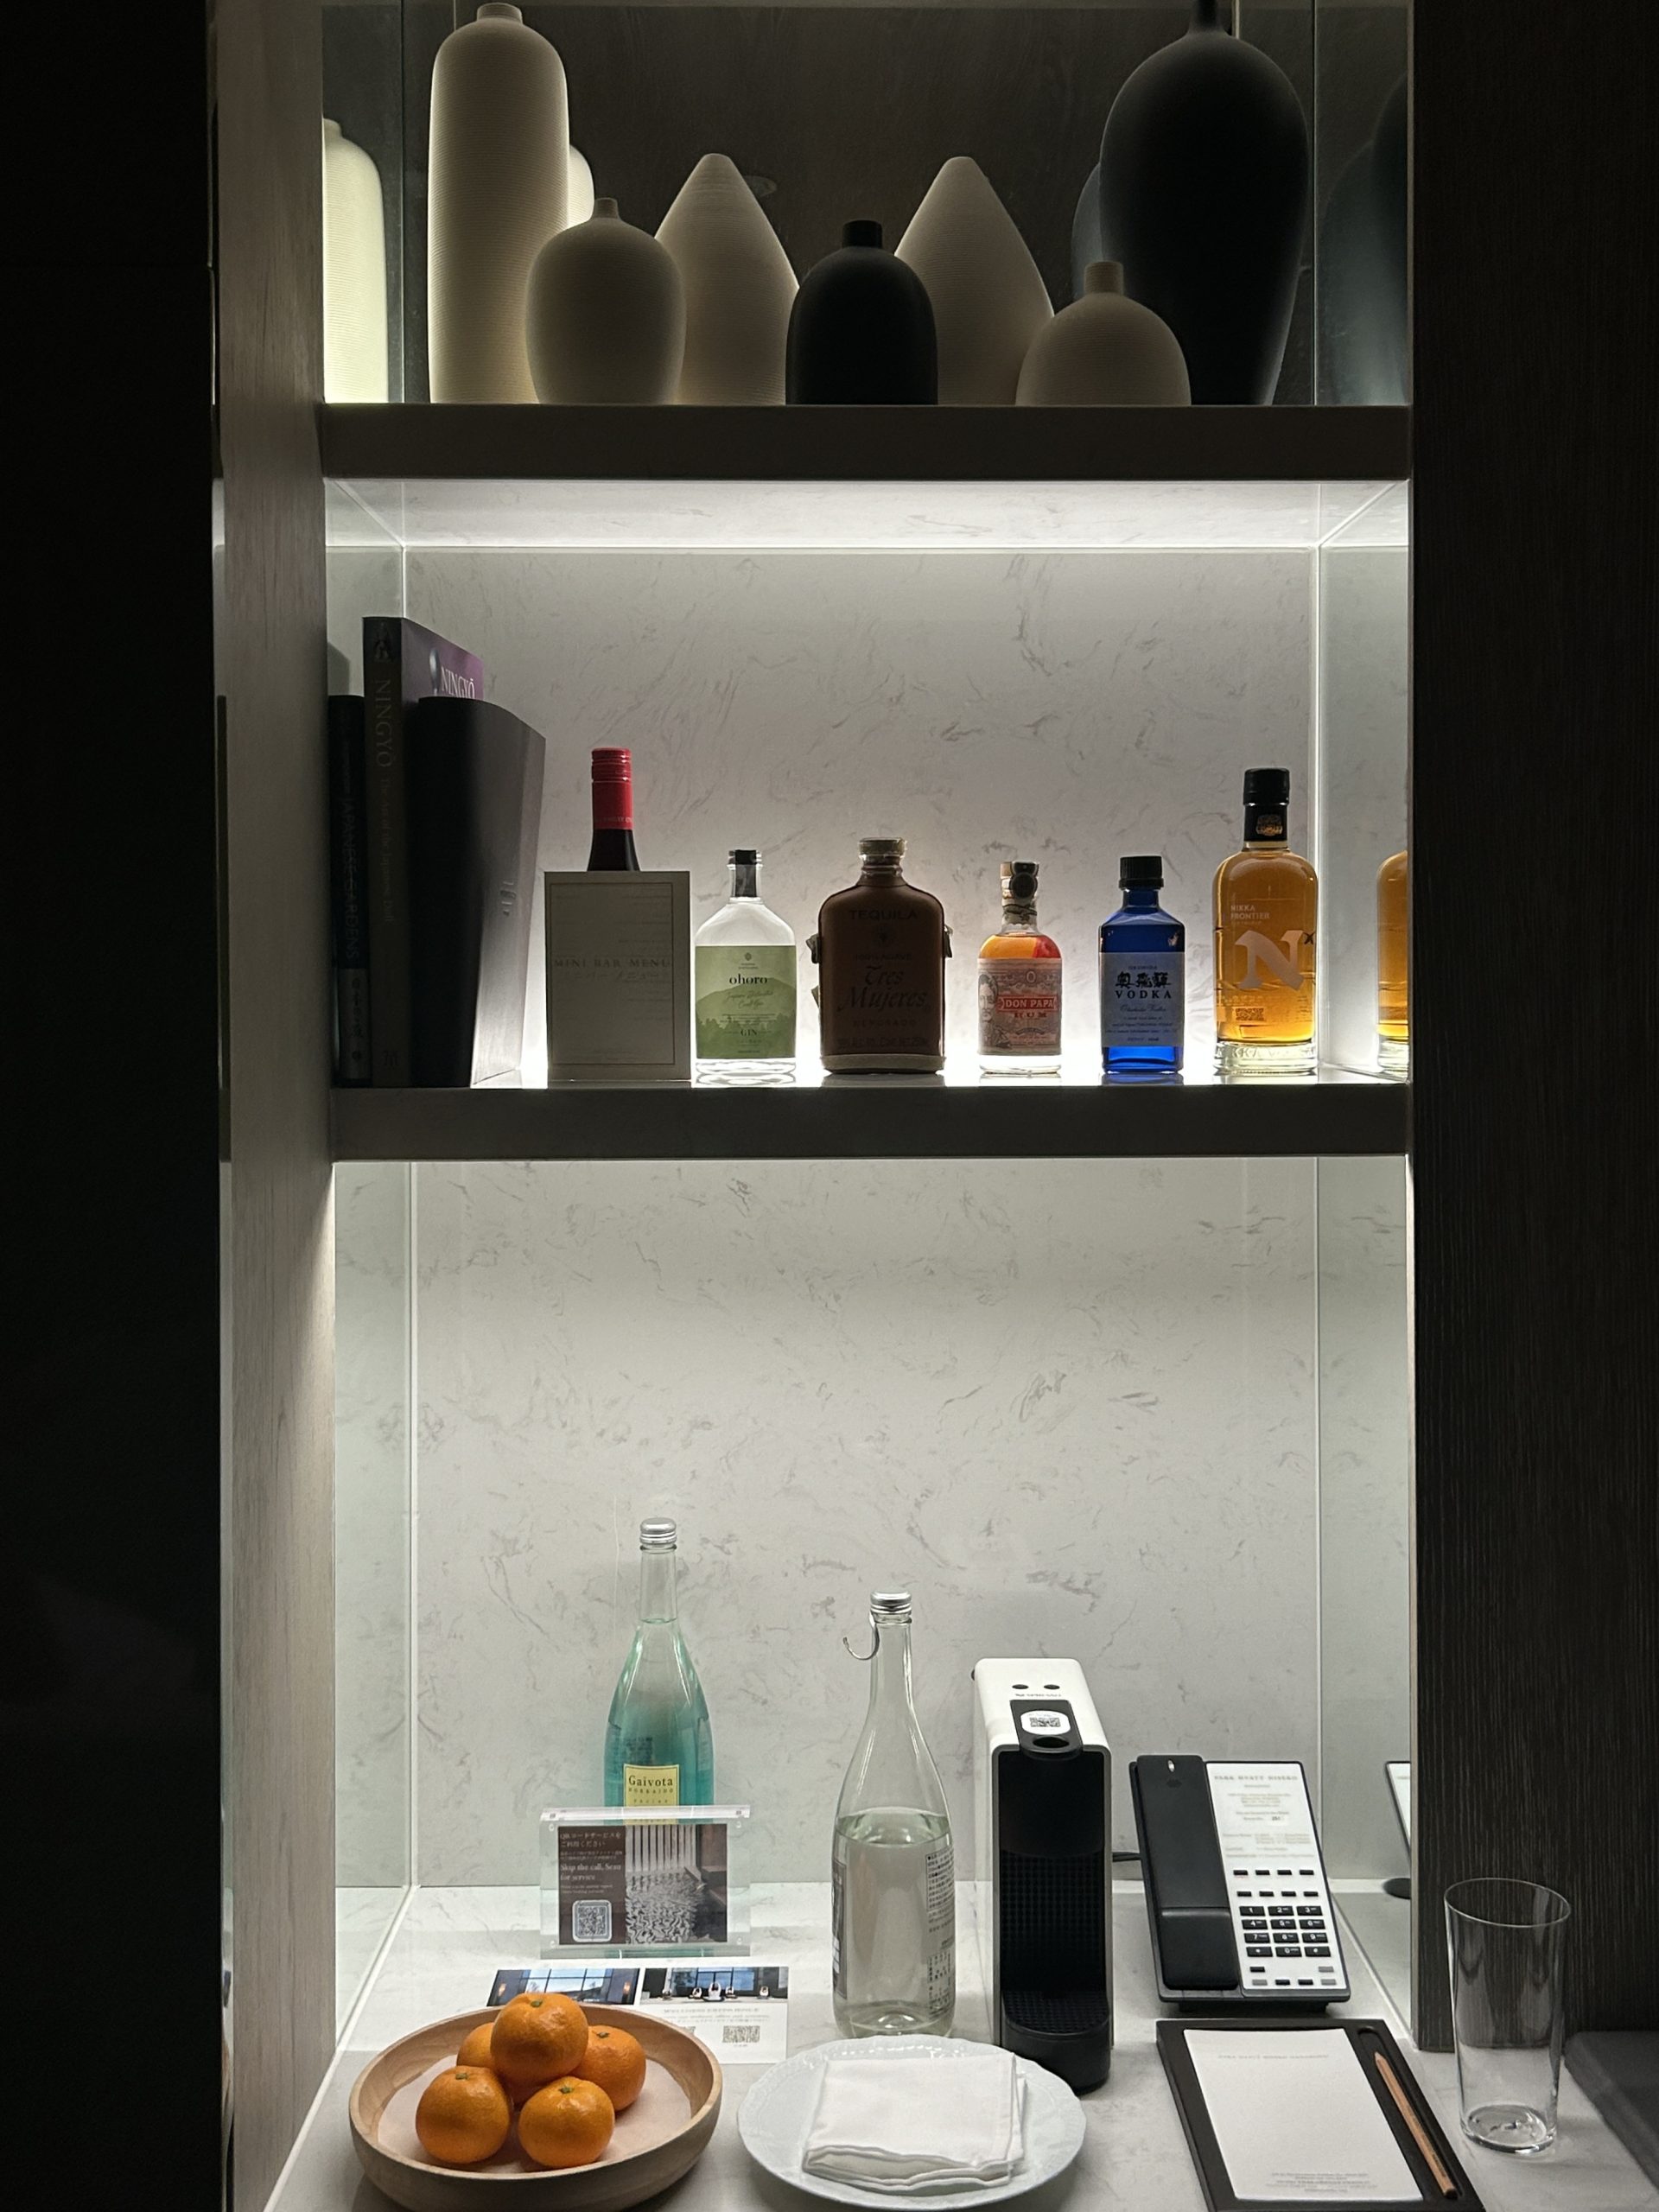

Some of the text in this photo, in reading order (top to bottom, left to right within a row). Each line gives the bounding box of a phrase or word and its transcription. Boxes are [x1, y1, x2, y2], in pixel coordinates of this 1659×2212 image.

[849, 909, 918, 921] TEQUILA
[554, 958, 586, 967] MINI
[594, 958, 620, 968] BAR
[1235, 930, 1304, 992] N
[728, 973, 768, 984] ohoro
[864, 964, 904, 986] Tres
[836, 986, 928, 1012] Mujeres
[1115, 990, 1172, 999] VODKA
[1006, 999, 1054, 1008] DON PAPA
[628, 1775, 674, 1787] Gaivota
